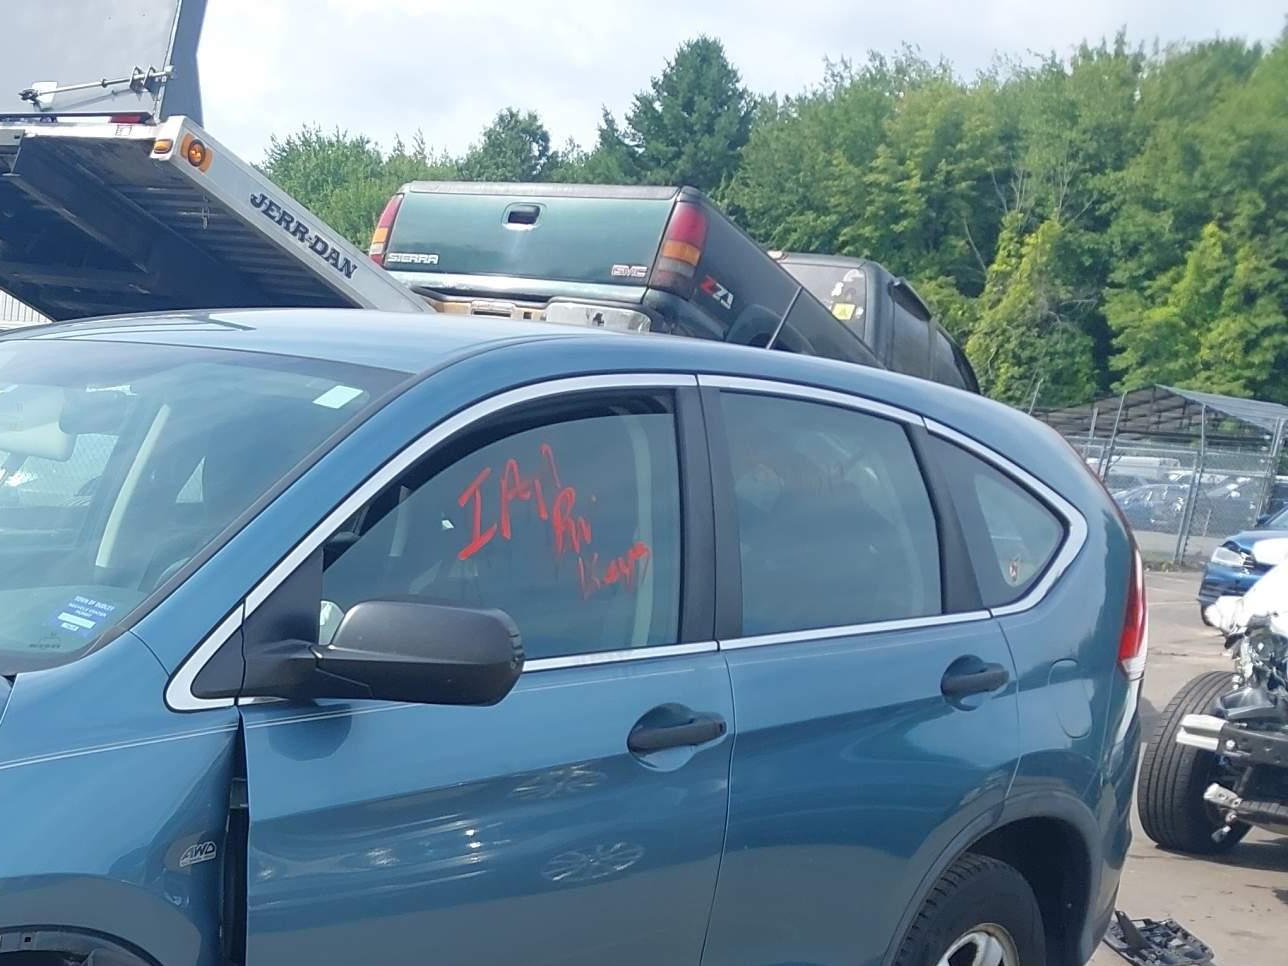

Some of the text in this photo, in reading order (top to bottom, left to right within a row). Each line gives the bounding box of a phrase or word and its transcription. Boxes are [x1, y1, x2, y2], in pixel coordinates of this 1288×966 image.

[250, 194, 357, 279] JERR-DAN
[388, 253, 439, 264] SIERRA
[612, 265, 648, 277] GMC
[701, 275, 734, 309] Z71
[181, 842, 217, 859] AWD
